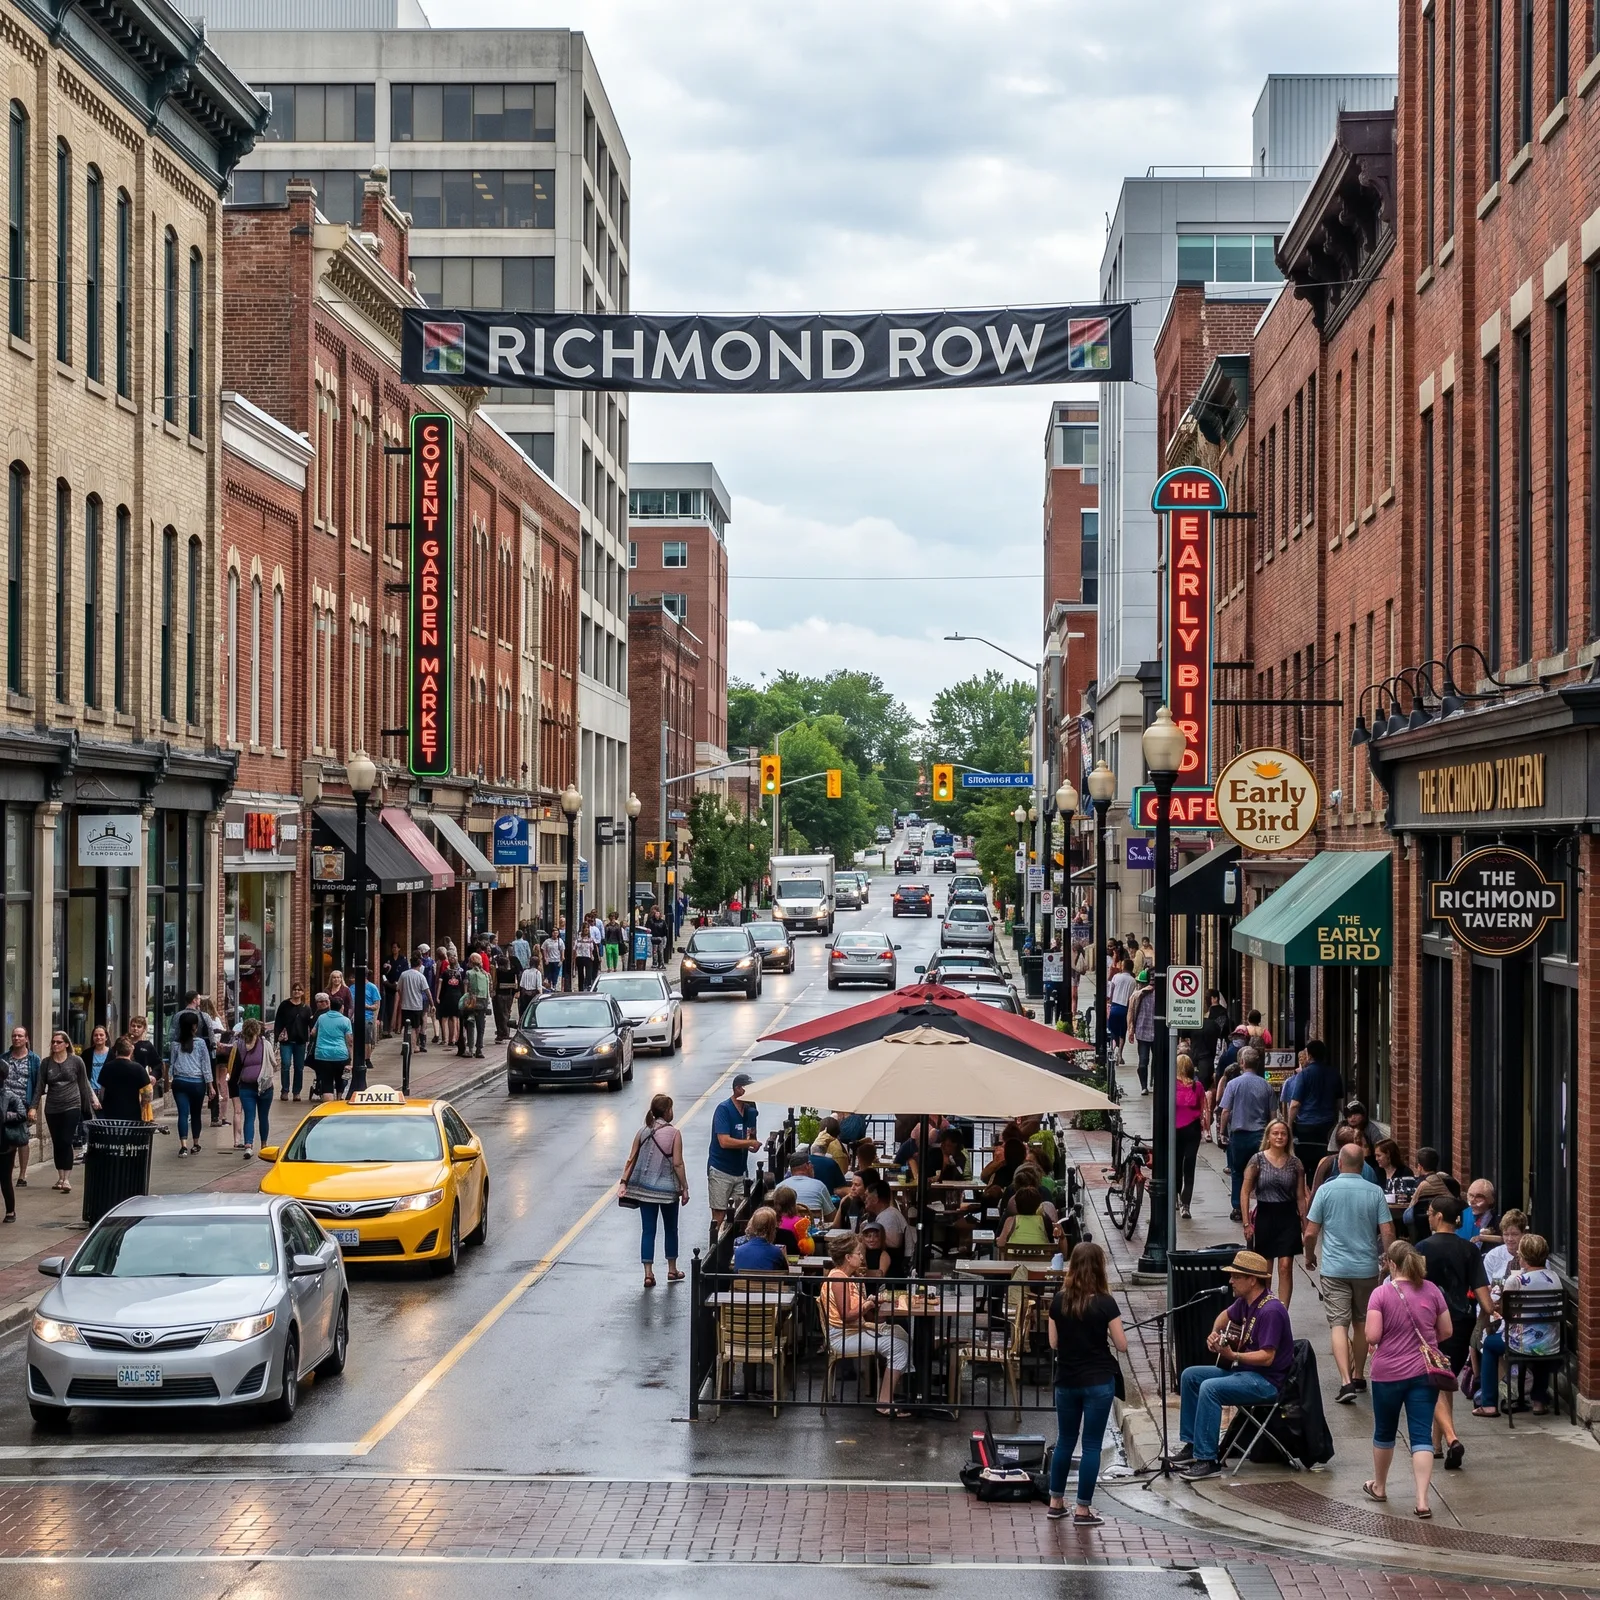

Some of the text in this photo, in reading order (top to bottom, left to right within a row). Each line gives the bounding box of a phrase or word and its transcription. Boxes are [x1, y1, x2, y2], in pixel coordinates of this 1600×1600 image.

[488, 323, 1046, 381] RICHMOND ROW
[1169, 482, 1210, 499] THE
[420, 425, 440, 764] COVENT GARDEN MARKET
[1177, 516, 1202, 772] EARLY BIRD
[1418, 752, 1545, 814] THE RICHMOND TAVERN
[1229, 779, 1307, 810] Early
[1235, 805, 1299, 832] Bird
[1255, 834, 1281, 844] CAFE
[1479, 870, 1516, 886] THE
[1439, 890, 1556, 909] RICHMOND
[1337, 915, 1361, 925] THE
[1462, 912, 1533, 928] TAVERN
[1317, 927, 1381, 942] EARLY
[1320, 944, 1380, 960] BIRD
